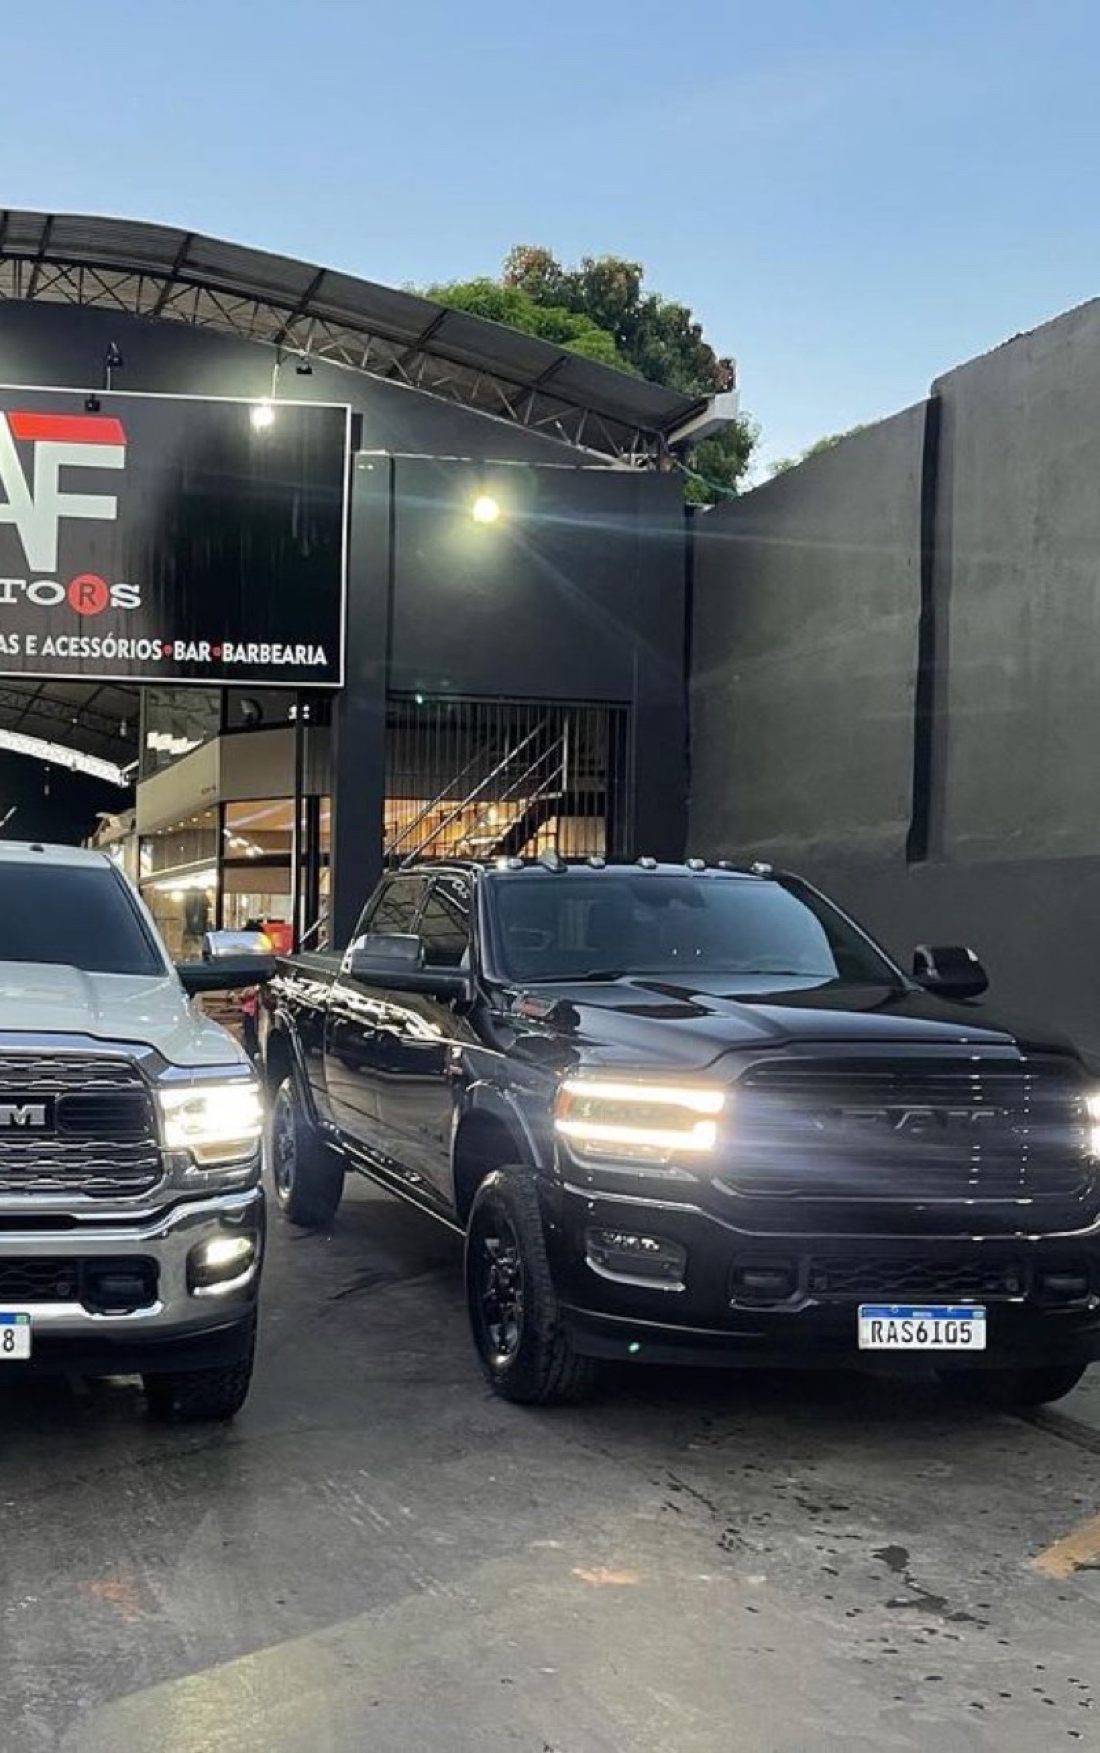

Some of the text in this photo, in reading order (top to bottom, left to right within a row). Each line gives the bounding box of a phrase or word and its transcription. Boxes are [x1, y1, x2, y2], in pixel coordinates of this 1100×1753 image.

[25, 634, 38, 656] E
[41, 632, 163, 660] ACESSÓRIOS
[173, 640, 213, 662] BAR
[221, 642, 328, 666] BARBEARIA
